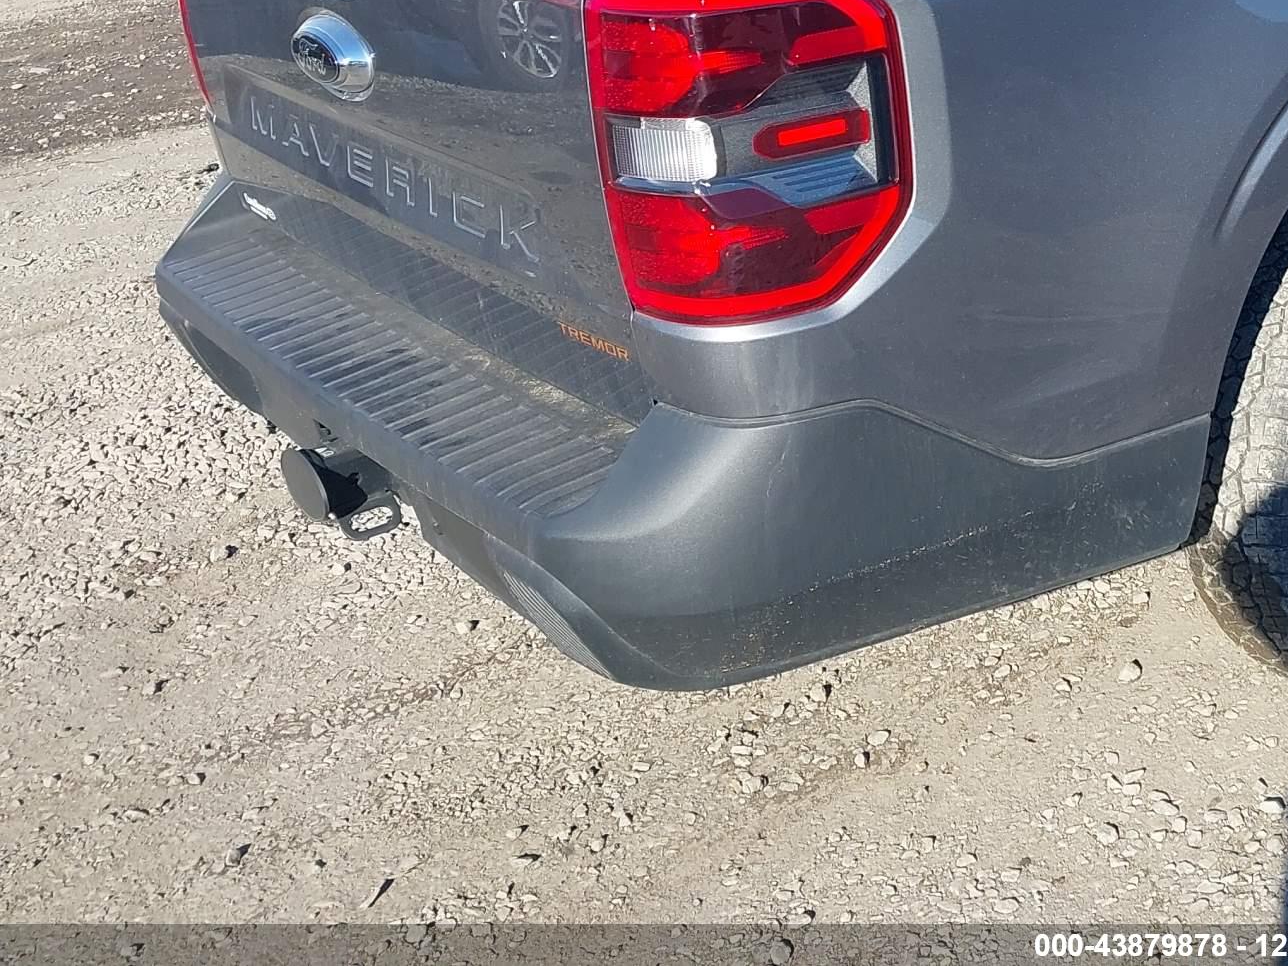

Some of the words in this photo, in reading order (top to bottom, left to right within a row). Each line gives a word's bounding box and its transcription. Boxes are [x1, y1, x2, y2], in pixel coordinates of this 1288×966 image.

[298, 37, 327, 75] Ford
[250, 95, 540, 263] MAVERICK
[556, 320, 630, 362] TREMOR
